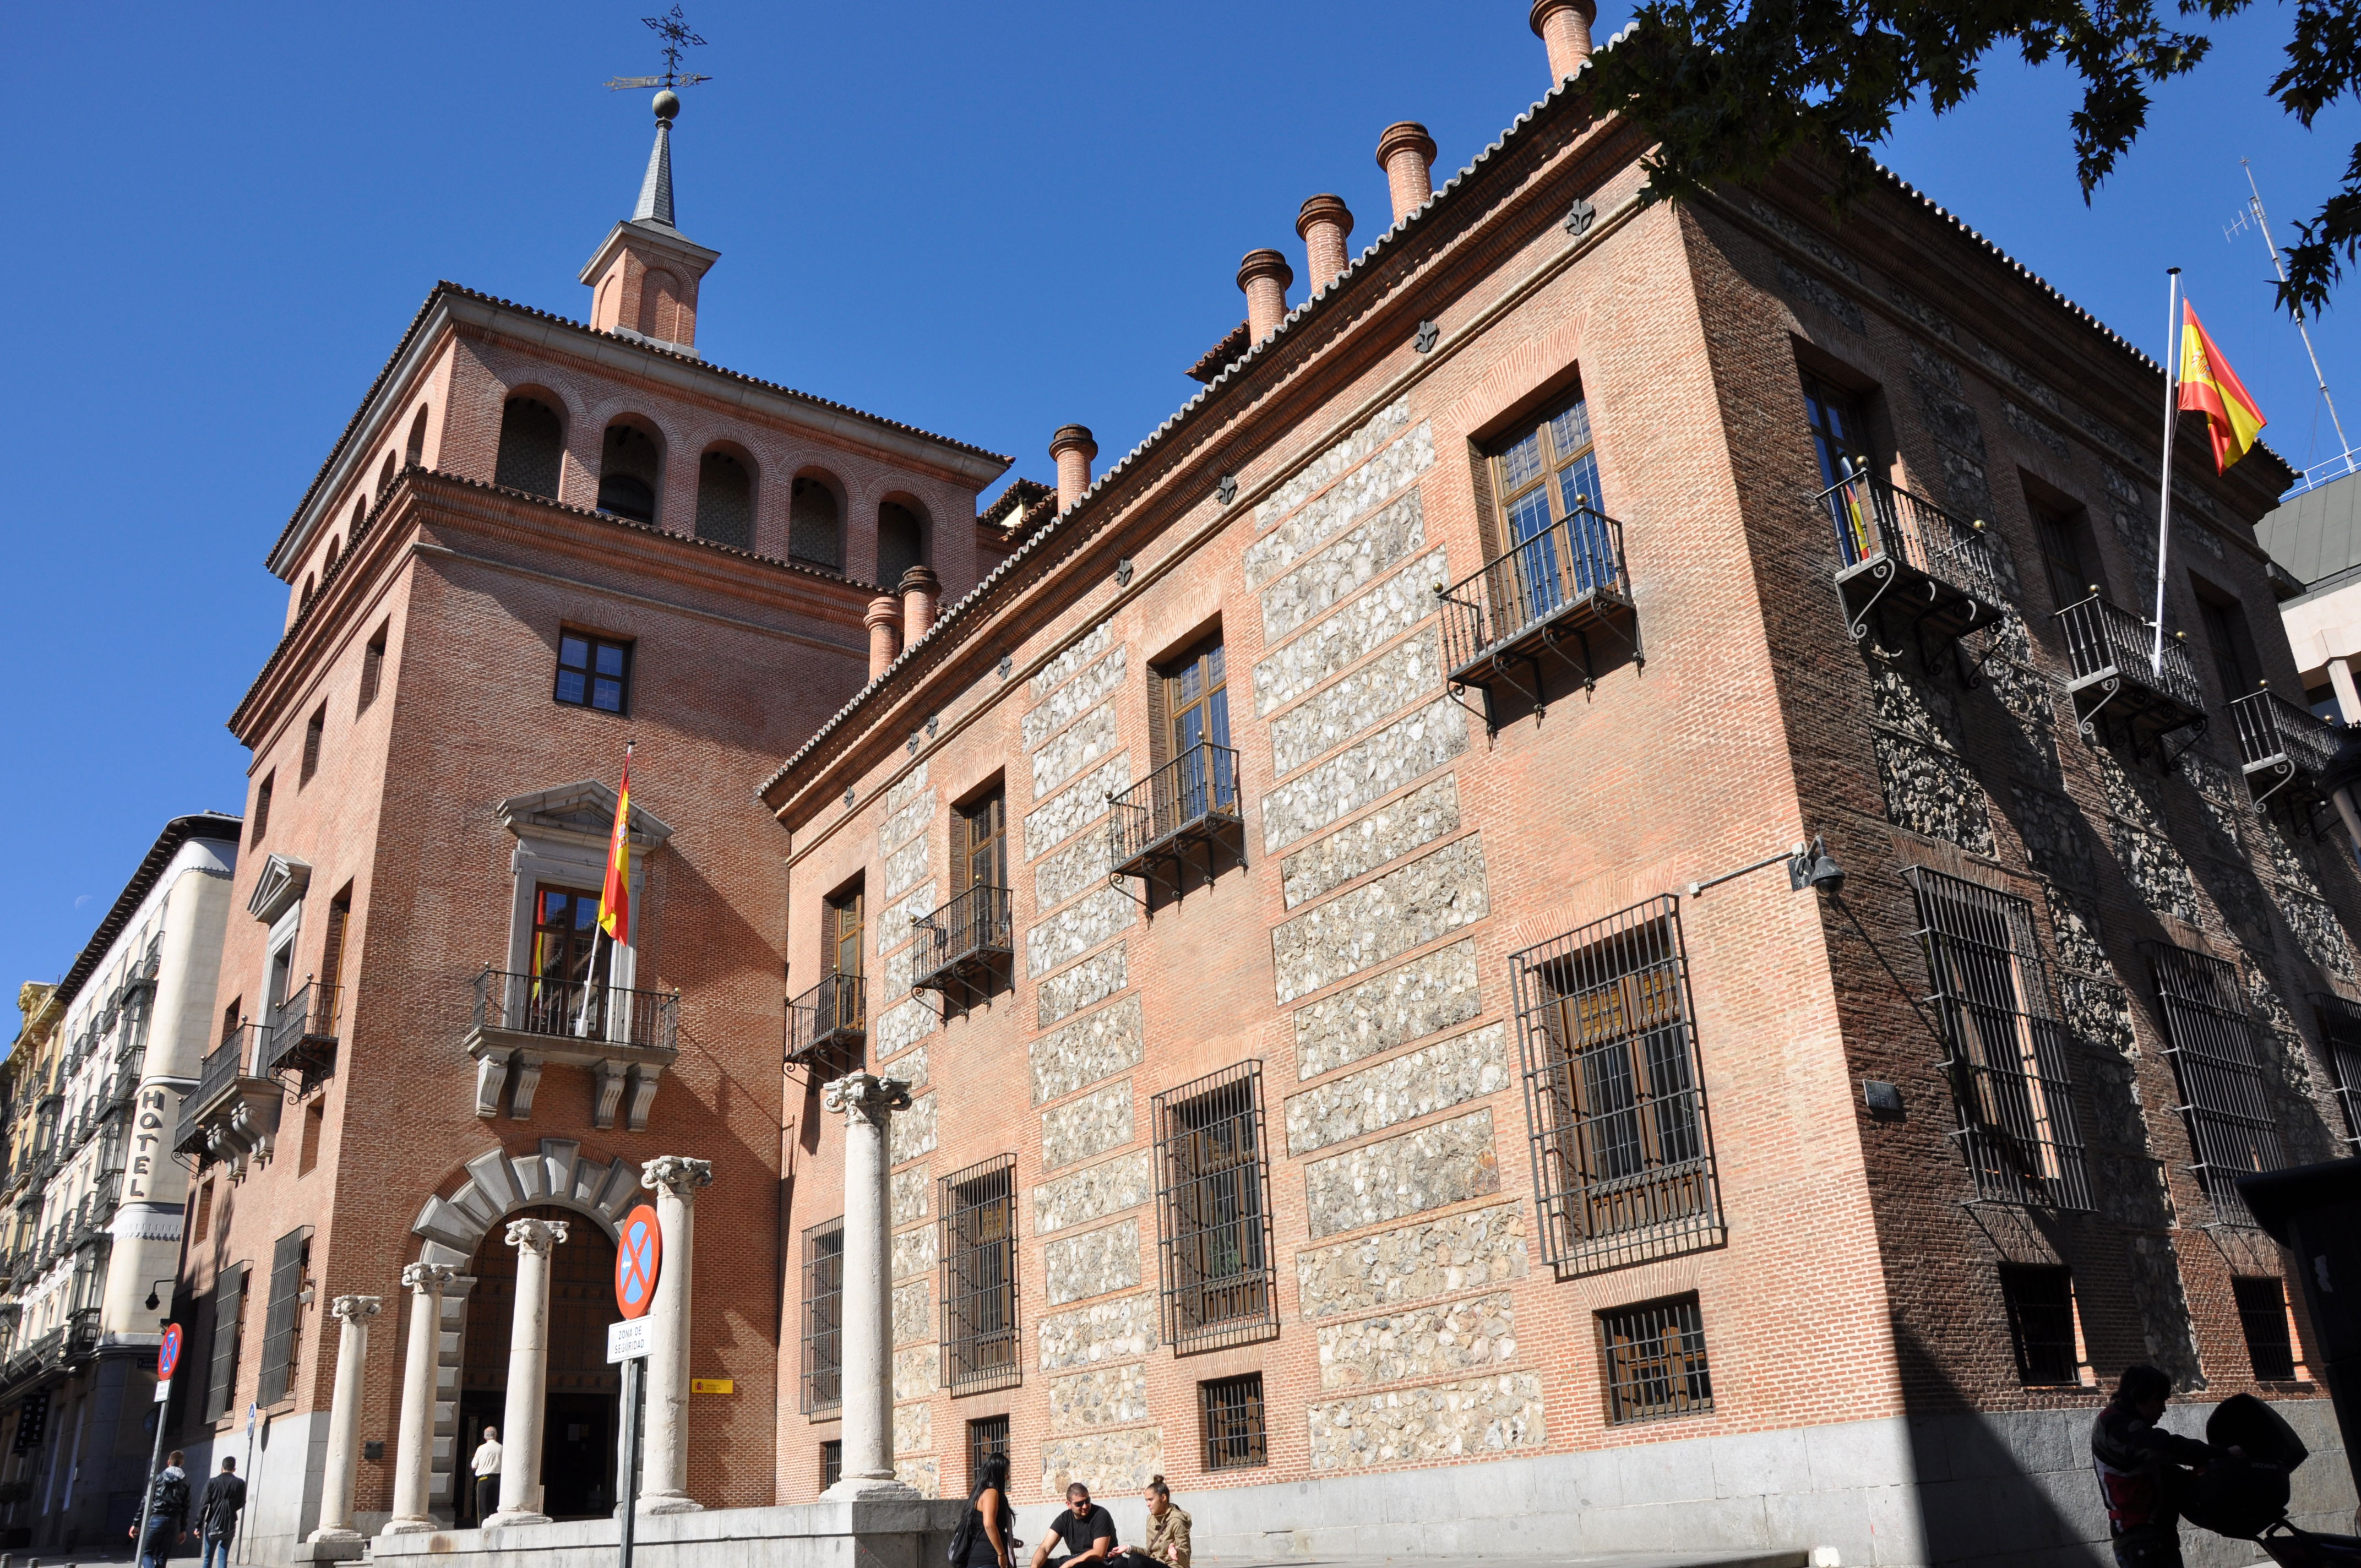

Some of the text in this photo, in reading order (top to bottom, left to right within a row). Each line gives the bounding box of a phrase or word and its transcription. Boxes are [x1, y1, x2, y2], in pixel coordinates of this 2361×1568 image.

[1874, 1096, 1891, 1107] REY
[130, 1090, 160, 1196] HOTEL
[615, 1339, 644, 1354] SEGURIDAD
[618, 1326, 641, 1340] ZONA DE
[19, 1406, 31, 1446] HOTEL
[33, 1397, 45, 1440] HOTEL
